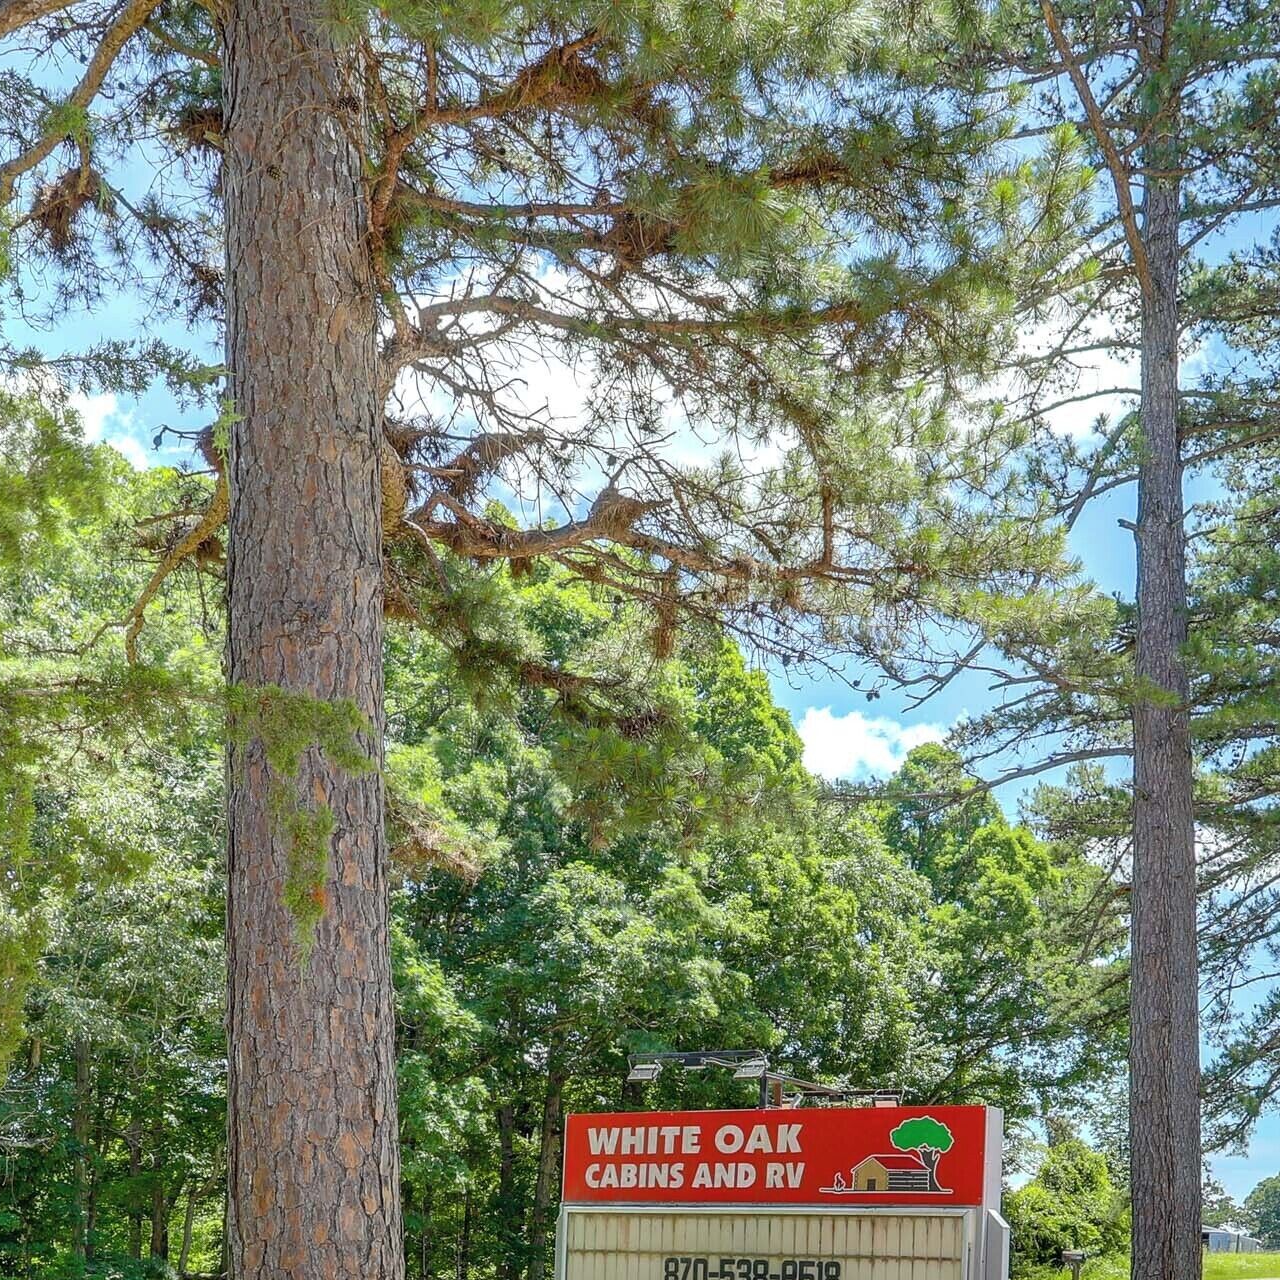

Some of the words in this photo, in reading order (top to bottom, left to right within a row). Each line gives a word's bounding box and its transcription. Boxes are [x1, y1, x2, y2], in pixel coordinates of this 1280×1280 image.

[587, 1126, 701, 1155] WHITE
[714, 1124, 803, 1154] OAK
[585, 1163, 684, 1189] CABINS
[691, 1163, 757, 1189] AND
[765, 1163, 805, 1189] RV
